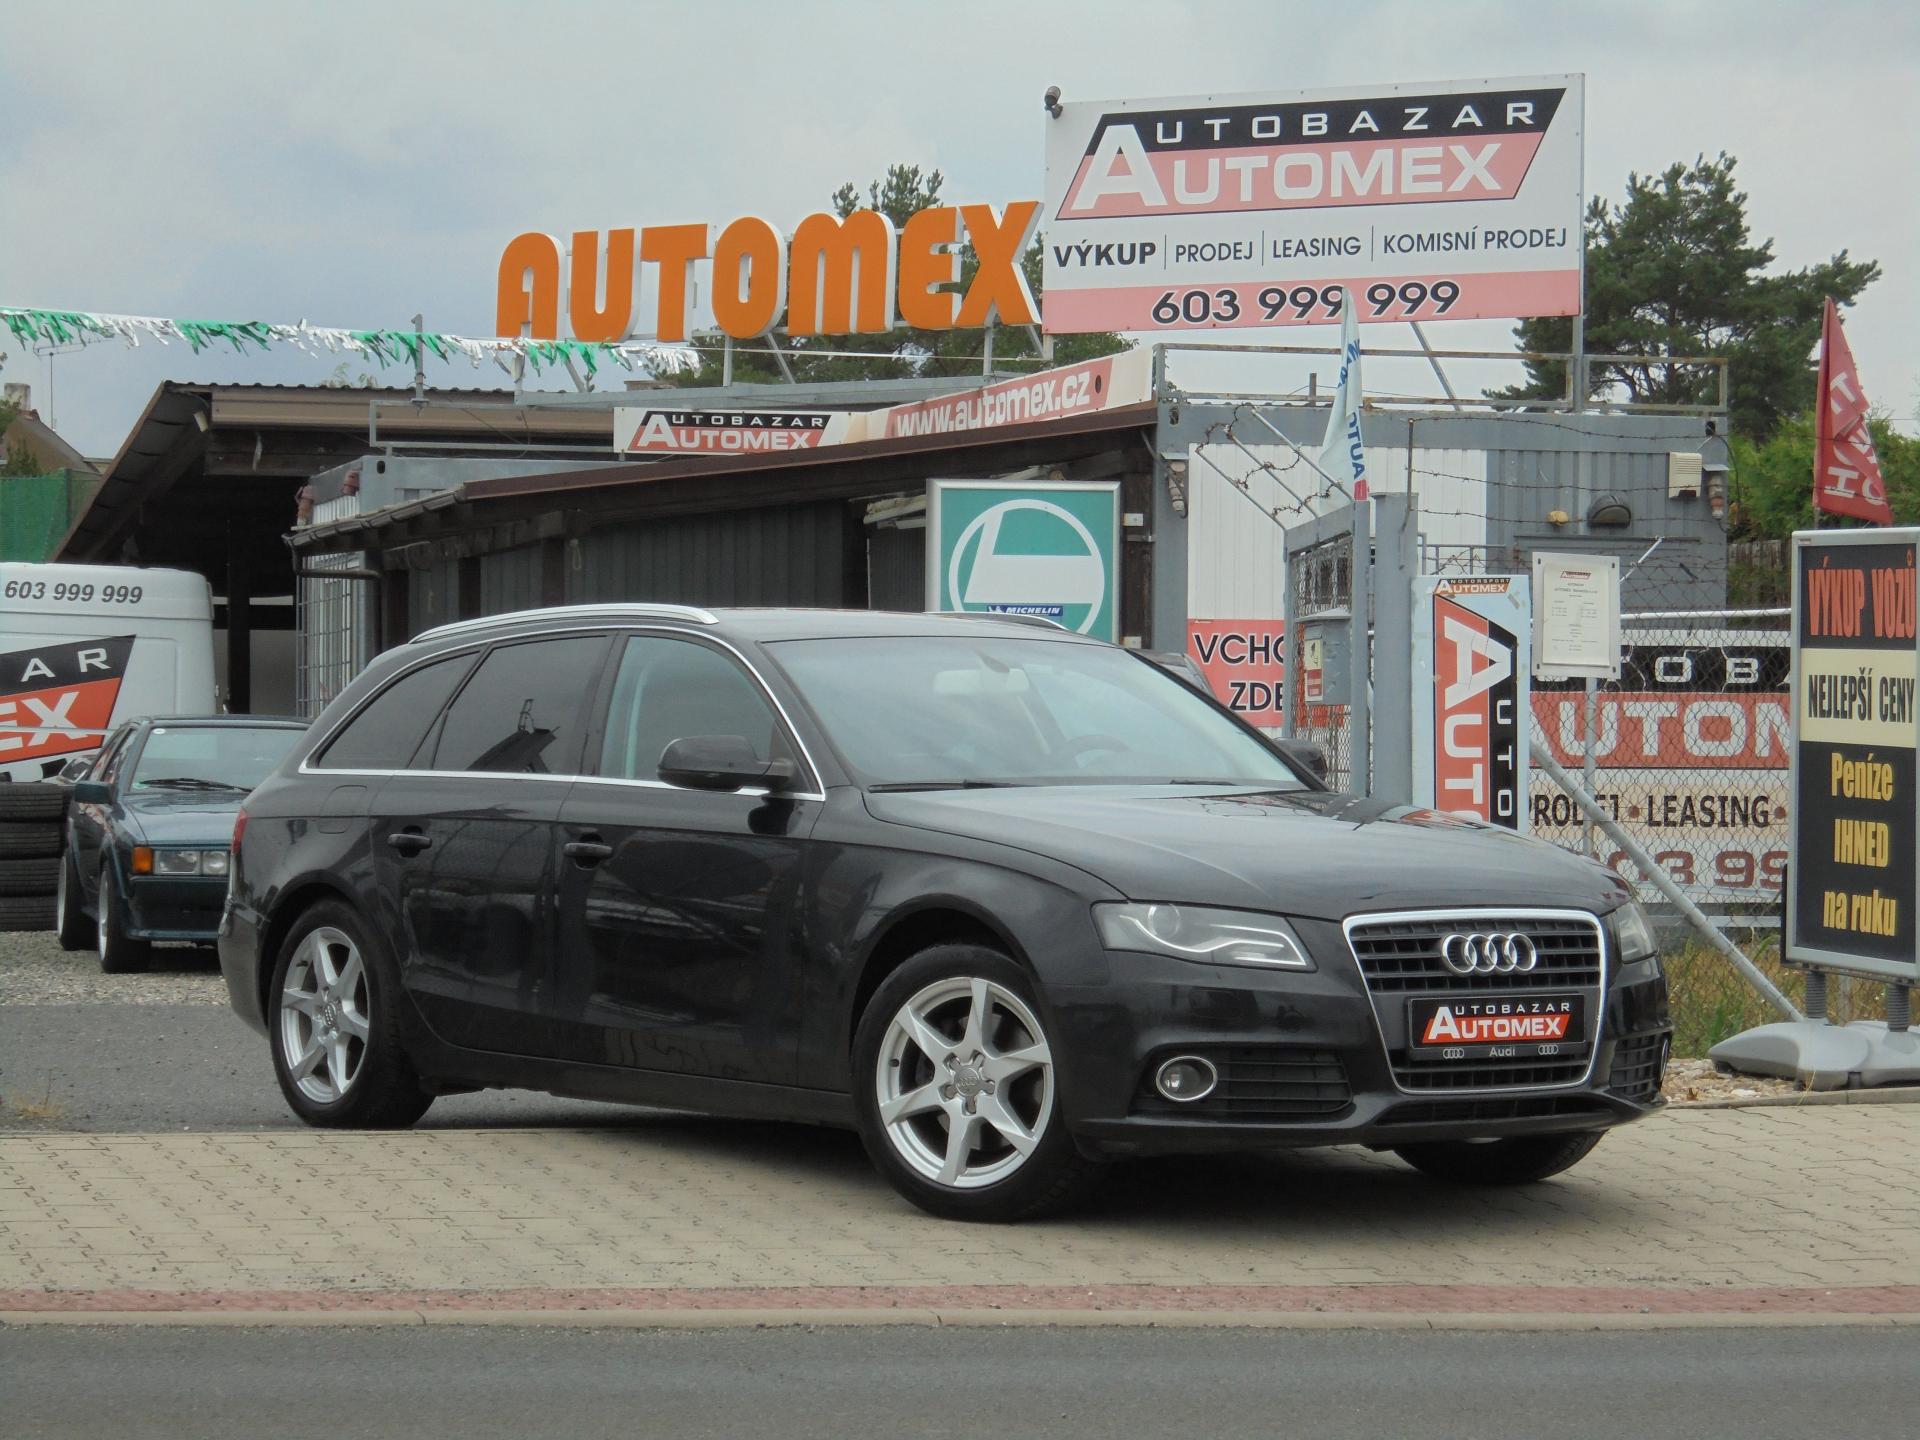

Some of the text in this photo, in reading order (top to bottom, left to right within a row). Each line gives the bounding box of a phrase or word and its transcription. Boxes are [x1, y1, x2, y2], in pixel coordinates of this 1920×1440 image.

[1071, 123, 1501, 211] AUTOMEX
[1053, 225, 1568, 269] VÝKUP PRODEJ LEASING KOMISNÍ PRODEJ
[495, 201, 1044, 343] AUTOMEX
[1151, 280, 1460, 325] 603 999 999
[897, 371, 1090, 437] www.automex.cz
[637, 413, 812, 450] AUTOMEX
[5, 580, 143, 605] 603 999 999
[1436, 580, 1506, 594] AUTOMEX
[1807, 549, 1916, 639] VÝKUP VOZŮ
[1005, 607, 1061, 615] MICHELIN
[1808, 666, 1916, 724] NEJLEPŠÍ CENY
[1831, 752, 1894, 802] Peníze
[1647, 794, 1770, 829] LEASING
[1833, 818, 1889, 868] IHNED
[1823, 889, 1897, 937] na ruku
[1428, 1006, 1562, 1040] AUTOMEX
[1489, 1046, 1516, 1058] Audi
